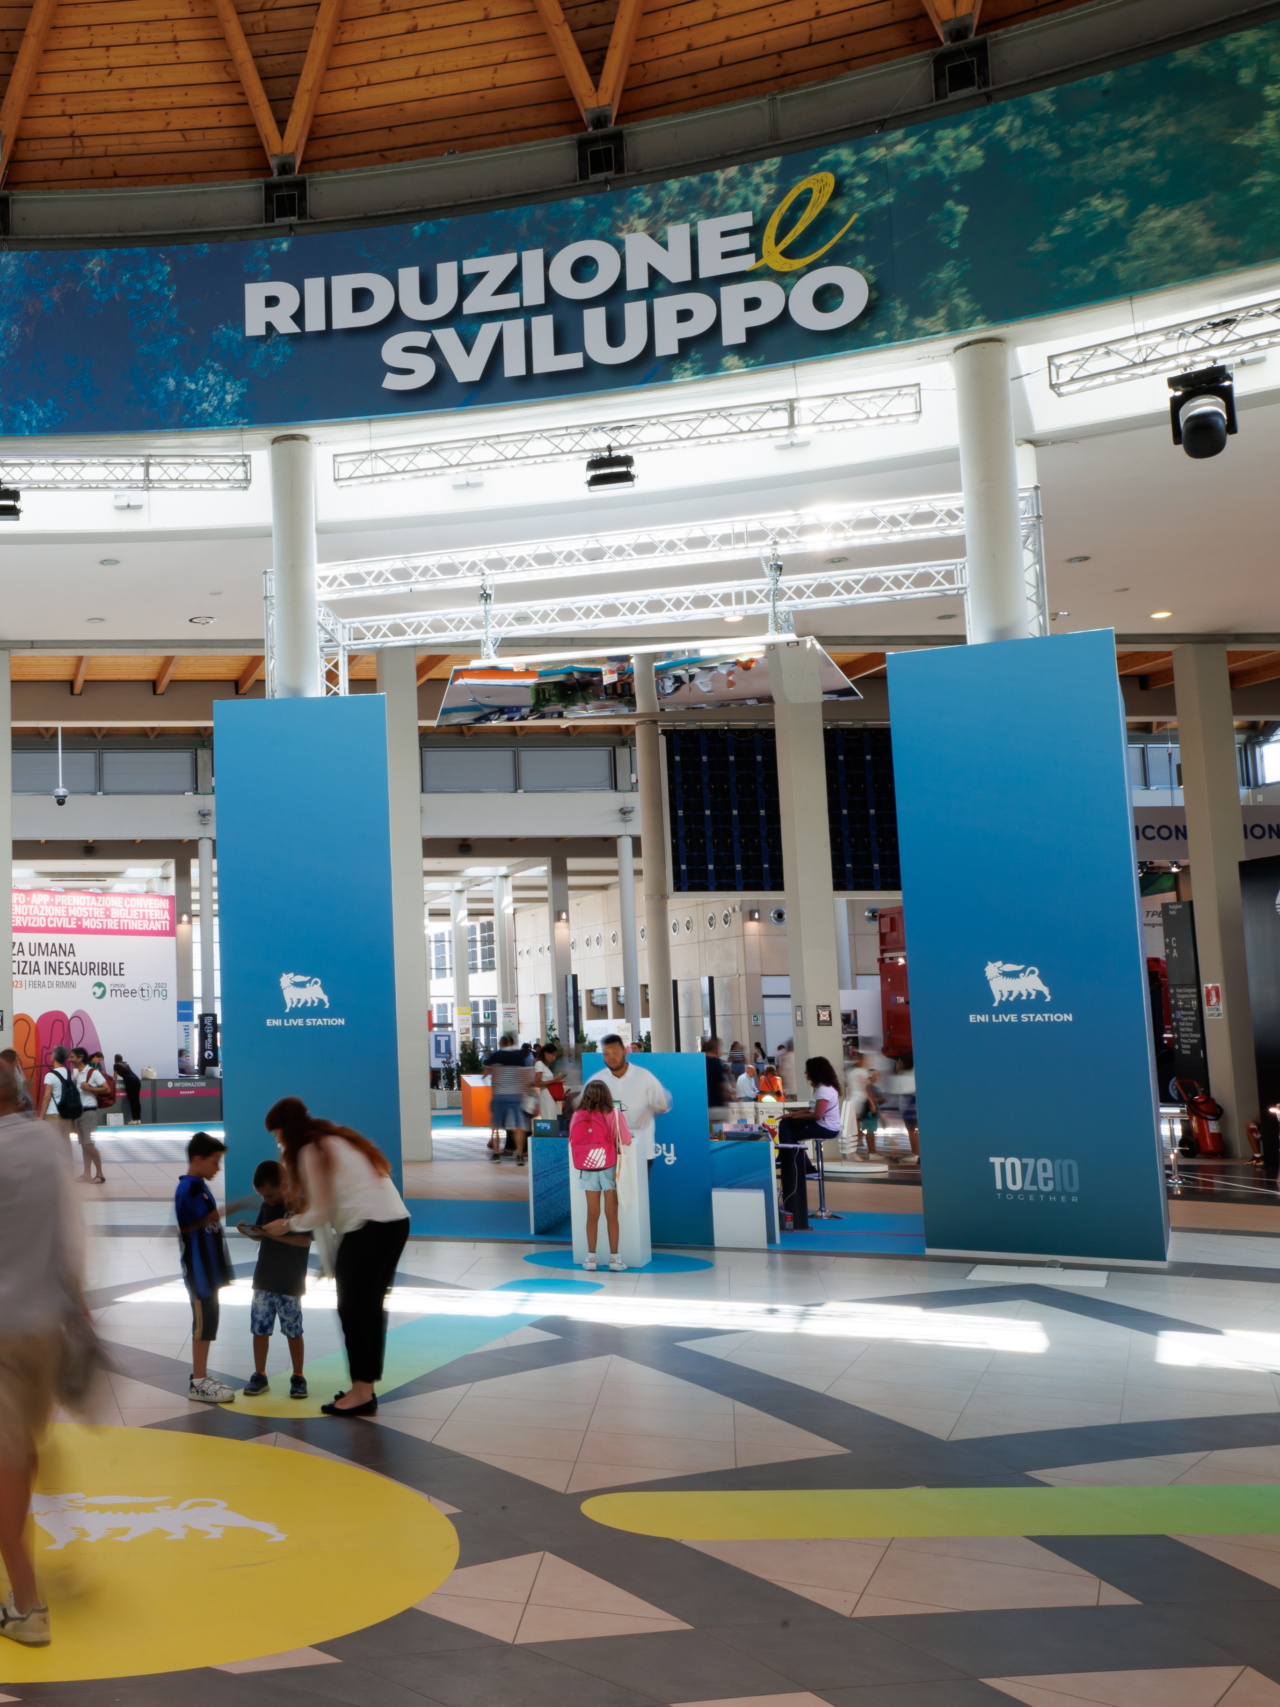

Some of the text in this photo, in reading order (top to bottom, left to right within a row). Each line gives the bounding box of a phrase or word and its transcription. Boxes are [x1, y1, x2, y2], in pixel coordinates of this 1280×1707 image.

[245, 171, 857, 336] RIDUZIONE e
[381, 266, 869, 390] SVILUPPO
[31, 894, 49, 904] APP
[55, 895, 123, 907] PRENOTAZIONE
[125, 897, 169, 909] CONVEGNI
[12, 905, 170, 920] ENOTAZIONE MOSTRE BIGLIETTERIA
[12, 916, 169, 930] ERVIZIO CIVILE MOSTRE ITINERANTI
[1172, 938, 1176, 946] C
[29, 943, 76, 957] UMANA
[1173, 949, 1178, 957] A
[44, 962, 125, 976] INESAURIBILE
[56, 981, 76, 989] RIMINI
[110, 985, 168, 1000] meeting
[306, 1018, 345, 1026] STATION
[969, 1013, 1073, 1022] ENI LIVE STATION
[437, 1036, 448, 1053] T
[996, 1193, 1078, 1202] TOGETHER
